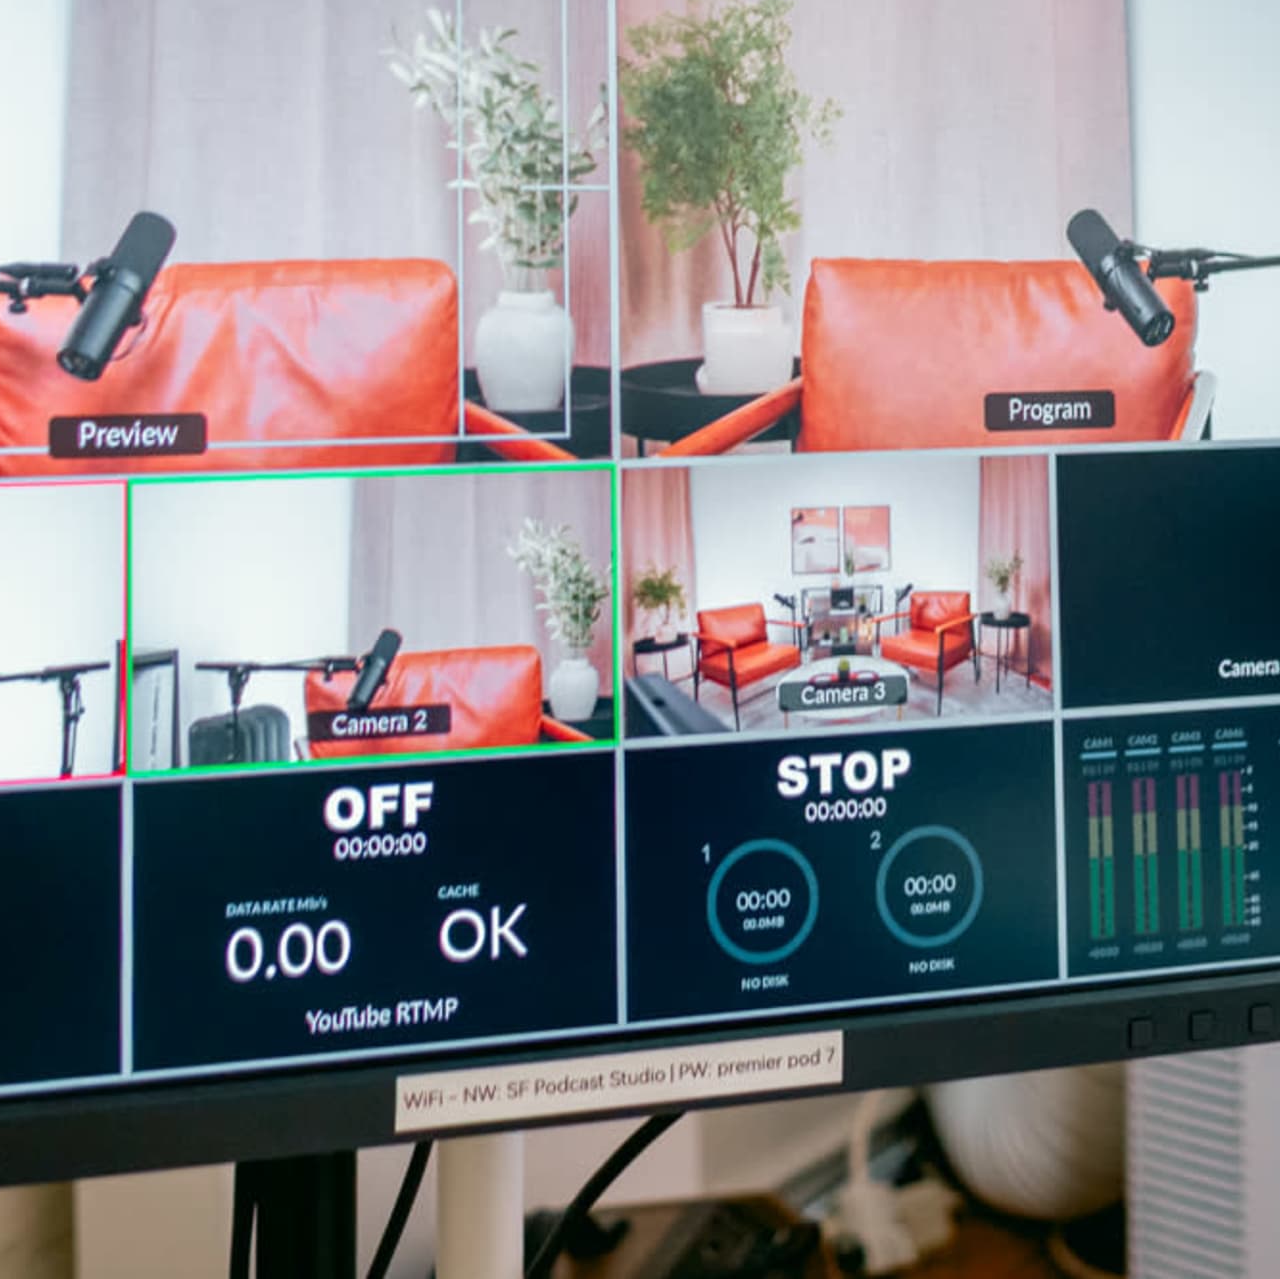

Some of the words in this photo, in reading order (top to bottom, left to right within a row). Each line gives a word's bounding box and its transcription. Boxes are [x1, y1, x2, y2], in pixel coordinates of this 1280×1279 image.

[1010, 398, 1091, 425] Program
[79, 421, 178, 447] Preview
[1219, 659, 1280, 678] Camera
[801, 685, 869, 705] Camera
[874, 681, 886, 701] 3
[332, 712, 408, 736] Camera
[415, 710, 426, 731] 2
[777, 749, 911, 797] STOP
[324, 782, 434, 832] OFF
[805, 797, 886, 822] 00:00:00
[334, 832, 426, 860] 00:00:00
[871, 831, 880, 849] 2
[702, 844, 709, 862] 1
[438, 884, 478, 899] CACHE
[904, 874, 956, 896] 00:00
[226, 898, 296, 917] DATARATE
[737, 889, 790, 911] 00:00
[440, 904, 526, 960] OK
[227, 920, 350, 980] 0.00
[909, 961, 928, 972] NO
[930, 959, 954, 971] DISK
[741, 977, 761, 990] NO
[762, 975, 788, 988] DISK
[306, 1005, 391, 1033] YouTube
[397, 998, 458, 1024] RTMP
[404, 1090, 443, 1110] WiFi
[464, 1084, 500, 1103] NW:
[507, 1080, 530, 1099] SF
[535, 1075, 603, 1094] Podcast
[610, 1069, 665, 1086] Studio
[679, 1062, 711, 1080] PW:
[718, 1058, 781, 1077] premier
[788, 1049, 820, 1068] pod
[826, 1046, 836, 1063] 7
